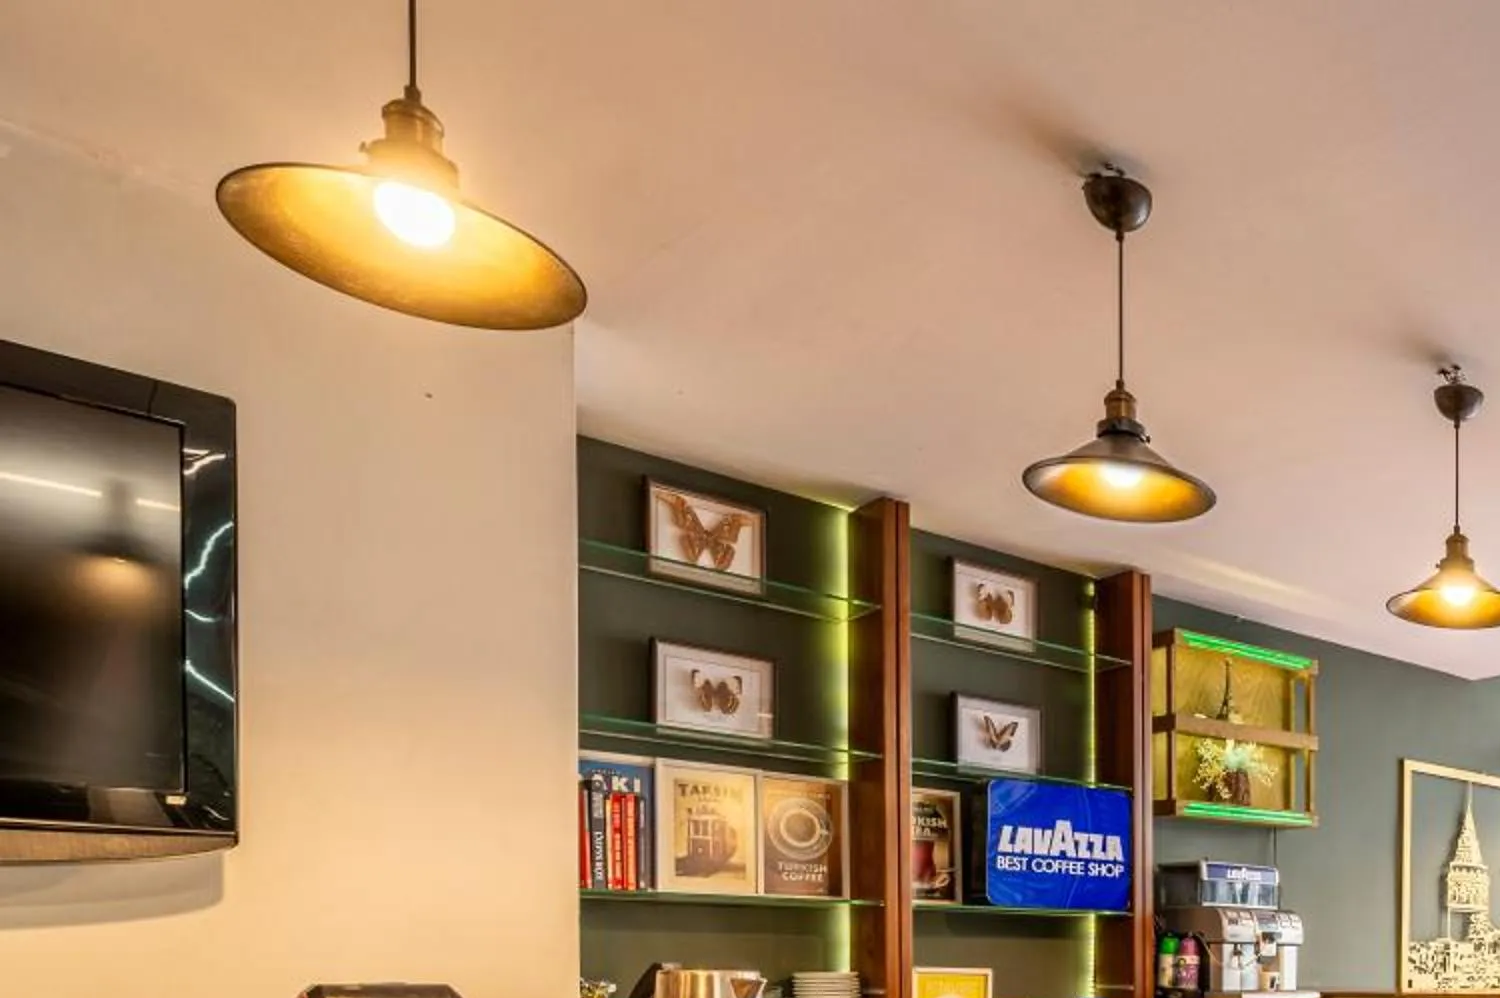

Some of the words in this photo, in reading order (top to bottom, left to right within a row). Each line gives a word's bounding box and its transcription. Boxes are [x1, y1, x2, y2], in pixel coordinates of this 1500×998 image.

[998, 819, 1125, 862] LAVAZZA
[778, 861, 828, 875] TURKISH
[997, 855, 1028, 871] BEST
[1031, 858, 1086, 876] COFFEE
[1088, 861, 1125, 879] SHOP
[781, 872, 825, 883] COFFEE
